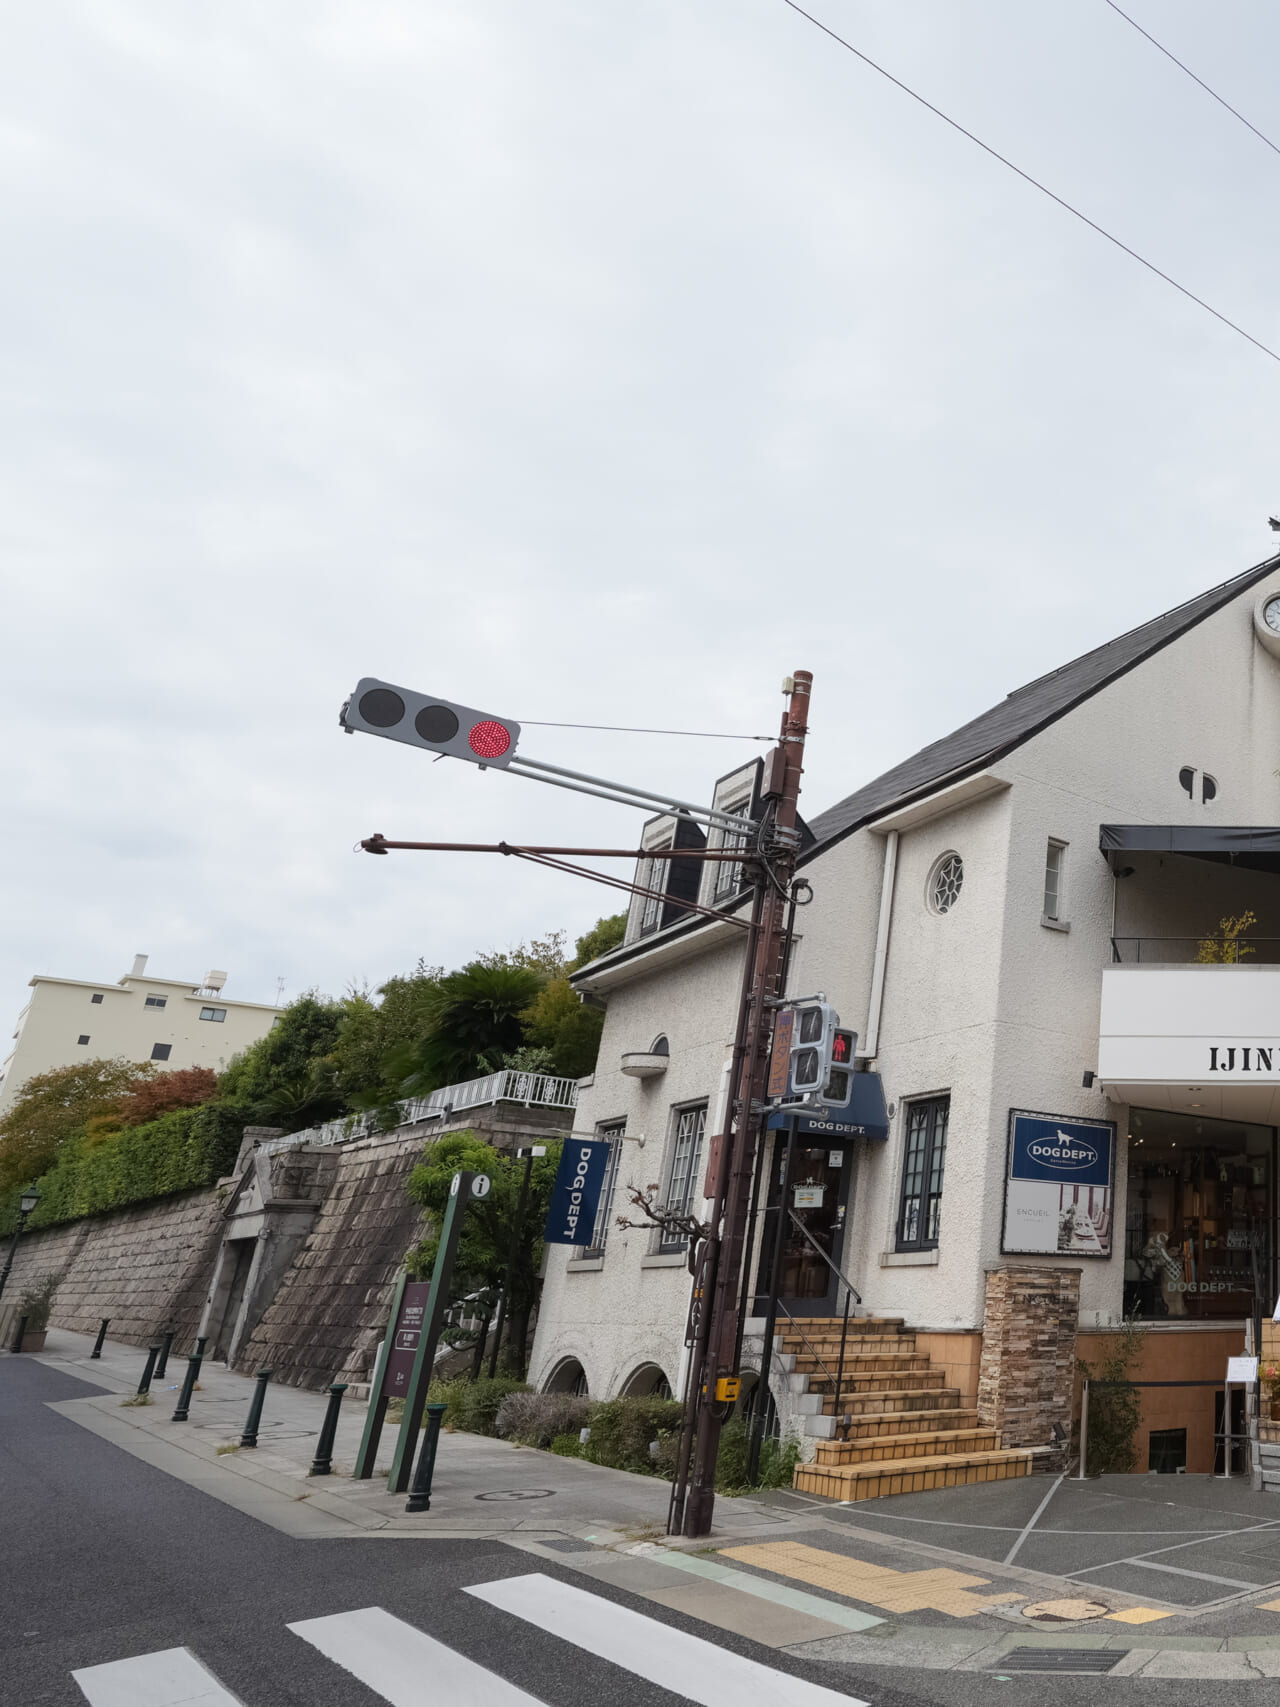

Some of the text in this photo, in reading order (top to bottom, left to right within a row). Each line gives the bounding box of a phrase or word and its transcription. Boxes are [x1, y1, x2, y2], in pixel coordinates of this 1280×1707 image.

[808, 1120, 834, 1131] DOG
[1032, 1145, 1061, 1158] DOG
[563, 1147, 592, 1240] DOG DEPT
[1016, 1208, 1050, 1217] ENCUEIL
[1167, 1281, 1197, 1292] DOG
